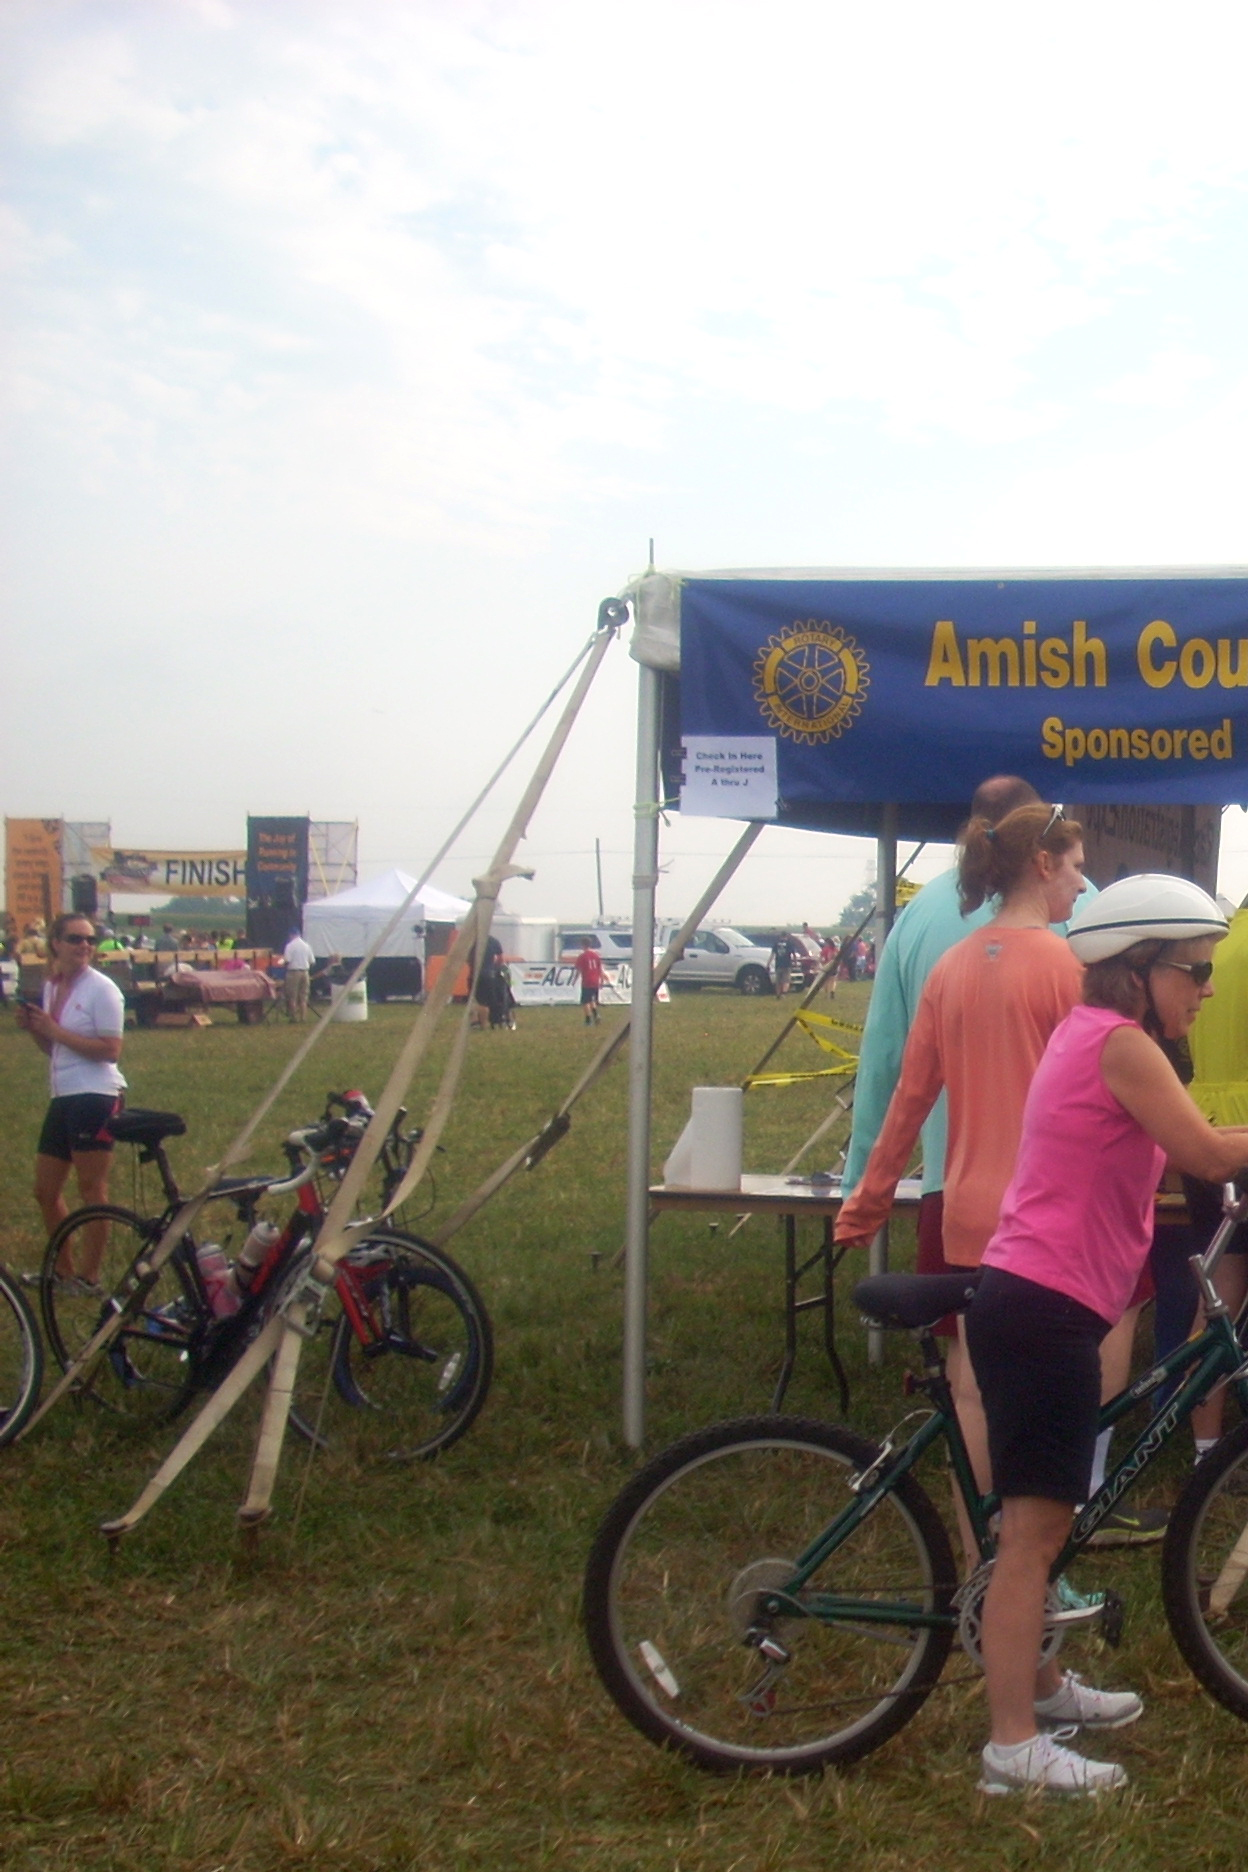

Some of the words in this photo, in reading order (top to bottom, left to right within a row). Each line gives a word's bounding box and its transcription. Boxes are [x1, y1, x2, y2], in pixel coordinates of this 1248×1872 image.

[794, 632, 835, 647] ROTARY
[925, 620, 1108, 689] Amish
[1041, 716, 1233, 767] Sponsored
[696, 752, 725, 760] Check
[728, 752, 738, 760] In
[740, 752, 763, 760] Here
[694, 765, 765, 774] Pre-Registered
[711, 778, 718, 786] A
[720, 778, 740, 786] thru
[742, 778, 749, 787] J
[165, 858, 246, 887] FINISH
[1072, 1402, 1178, 1542] GIANT
